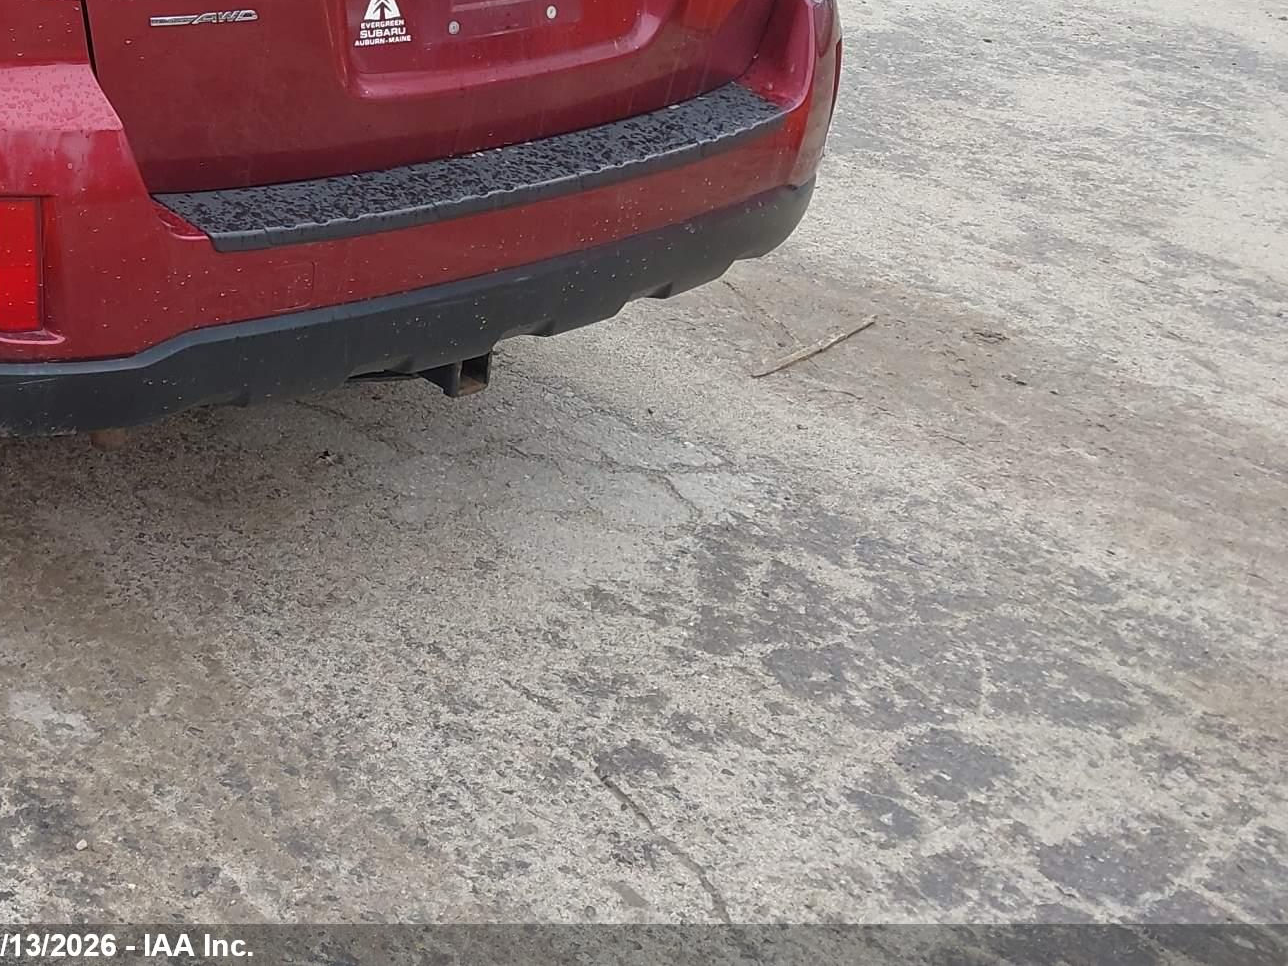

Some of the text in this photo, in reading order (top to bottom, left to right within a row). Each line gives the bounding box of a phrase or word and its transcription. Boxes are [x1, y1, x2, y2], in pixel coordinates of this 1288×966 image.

[191, 9, 259, 25] AWD
[360, 19, 405, 30] EVERGREEN
[359, 27, 406, 39] SUBARU
